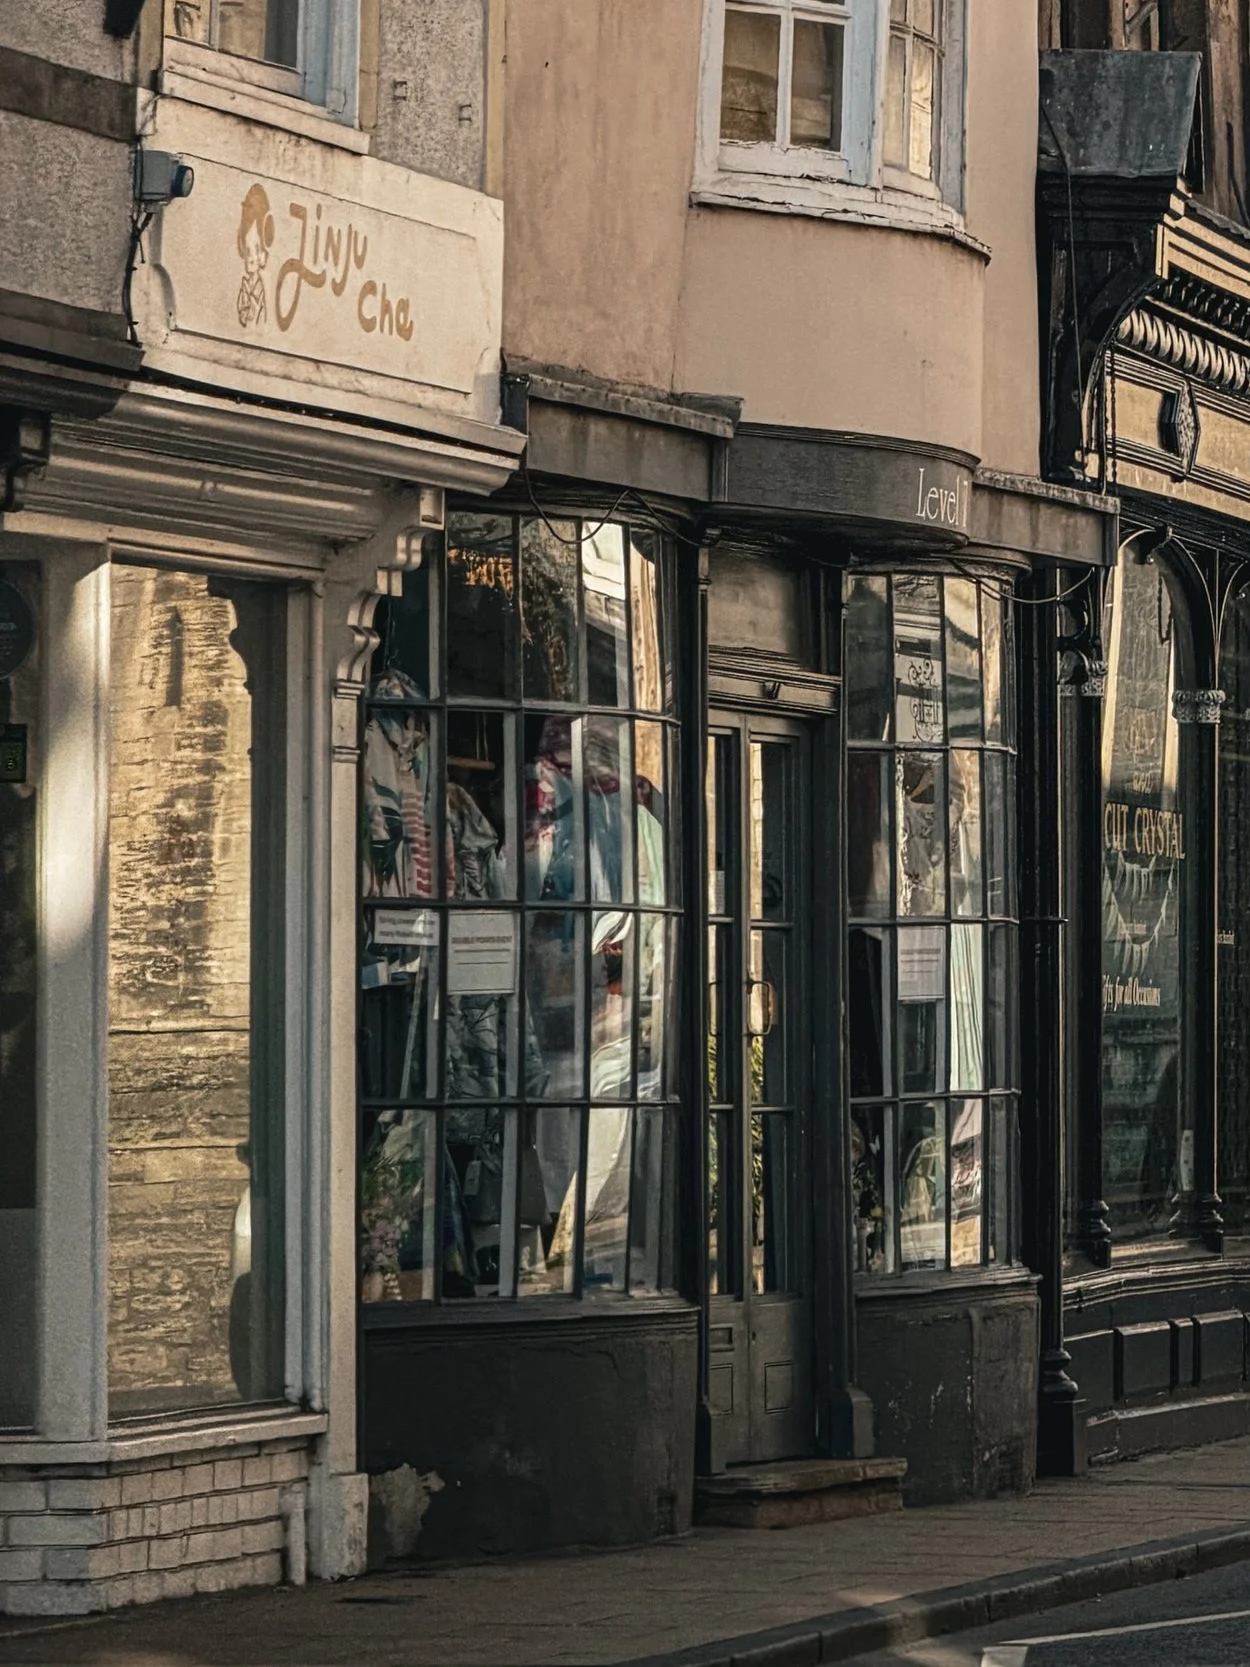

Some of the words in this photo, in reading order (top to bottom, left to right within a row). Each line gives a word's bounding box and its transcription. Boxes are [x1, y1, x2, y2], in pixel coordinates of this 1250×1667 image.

[916, 468, 960, 526] Level
[1104, 802, 1129, 852] CUT
[1134, 806, 1186, 860] CRYSTAL
